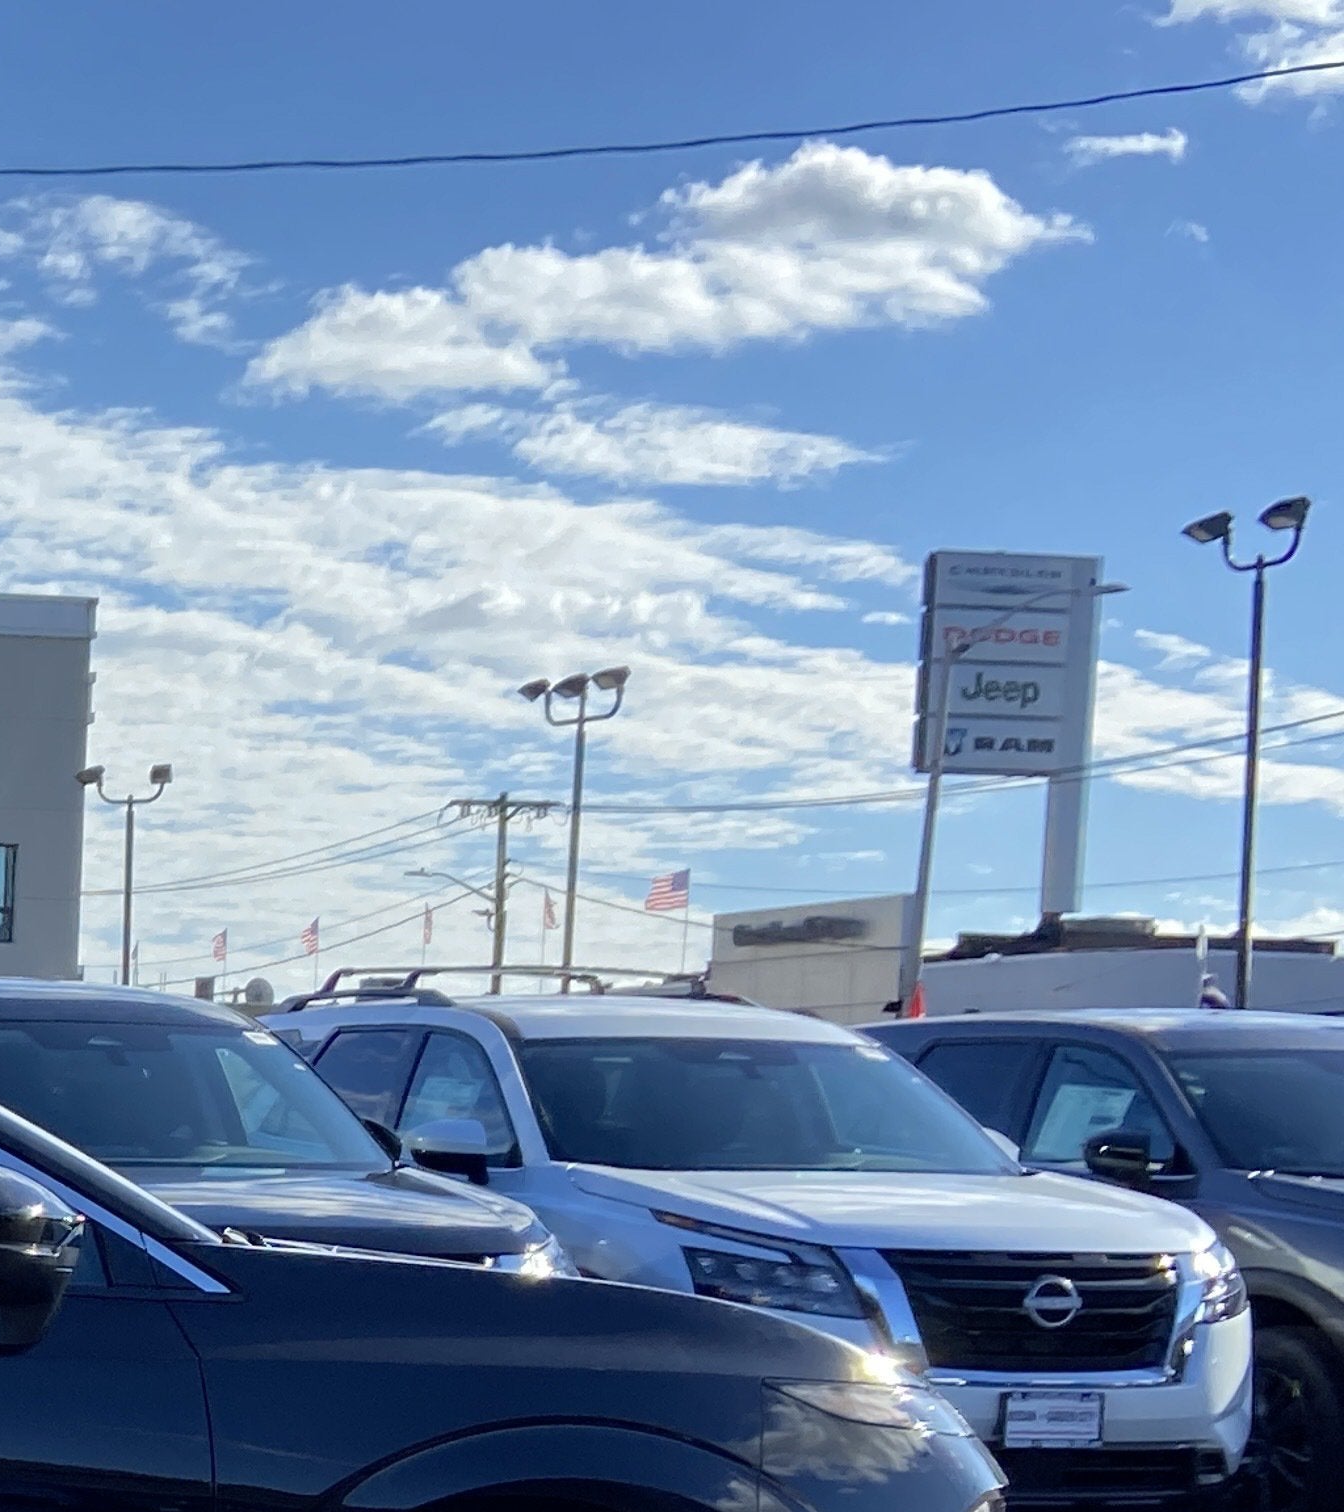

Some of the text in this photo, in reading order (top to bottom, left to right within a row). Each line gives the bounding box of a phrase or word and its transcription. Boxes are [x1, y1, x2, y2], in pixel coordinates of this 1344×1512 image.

[943, 626, 1060, 646] DDGE
[961, 672, 1041, 708] Jeep
[974, 736, 1056, 753] RAM
